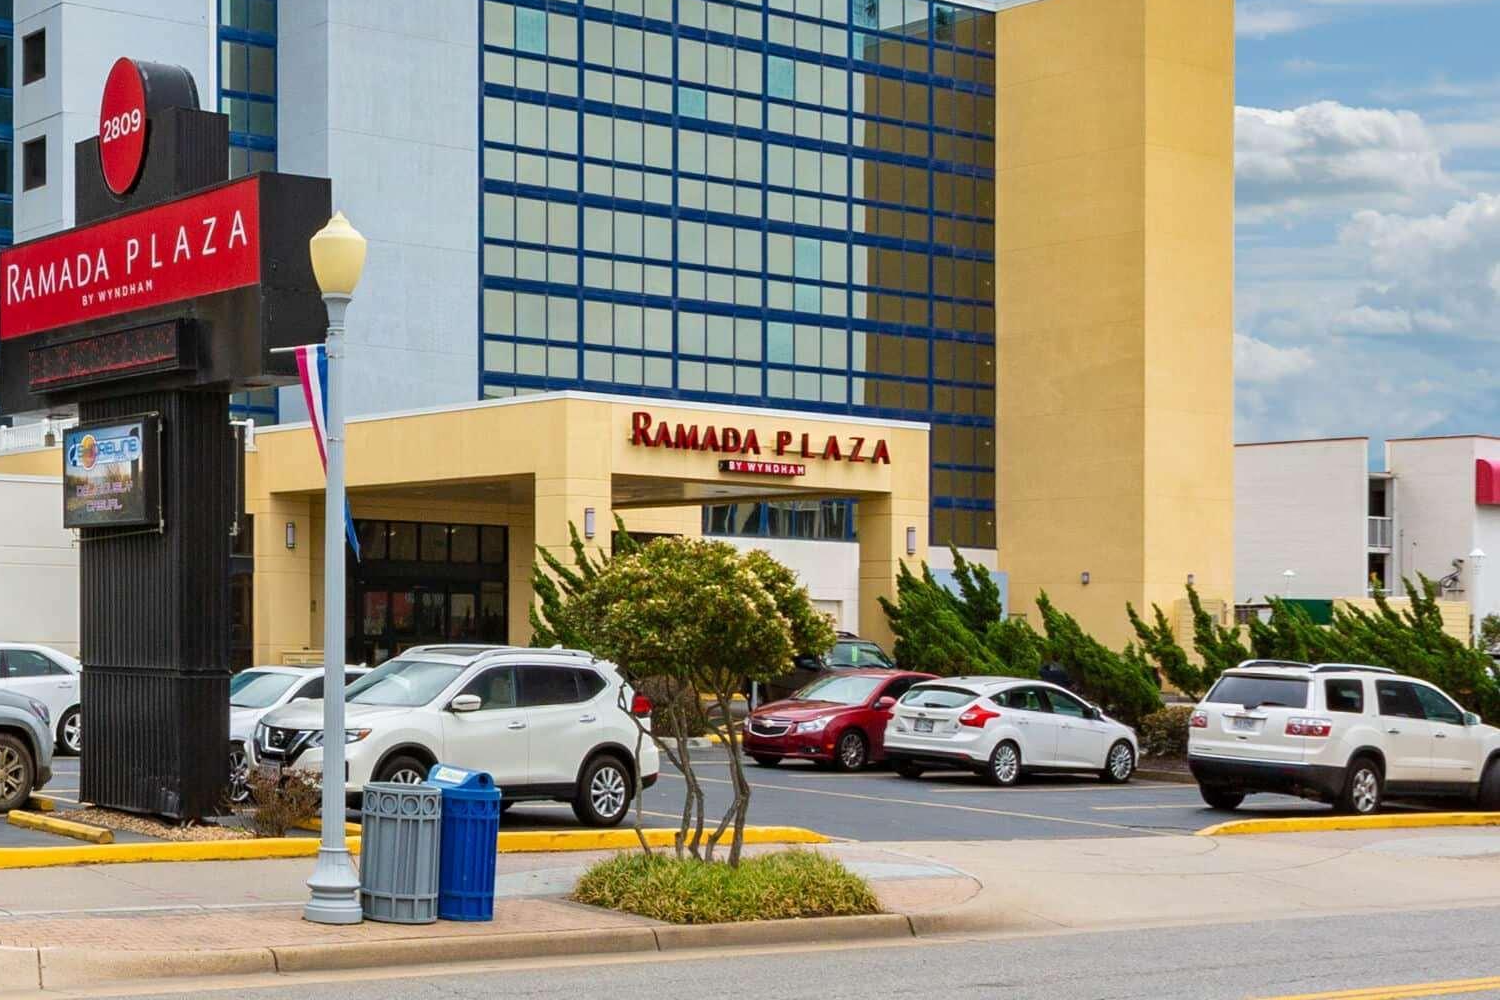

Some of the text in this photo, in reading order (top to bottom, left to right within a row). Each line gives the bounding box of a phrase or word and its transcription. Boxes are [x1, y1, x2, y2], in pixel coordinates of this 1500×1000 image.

[103, 108, 141, 144] 2809
[6, 209, 248, 306] RAMADA PLAZA
[82, 279, 153, 307] BY WYNDHAM
[630, 411, 891, 465] RAMADA PLAZA
[729, 461, 804, 474] BY WYNDHAM
